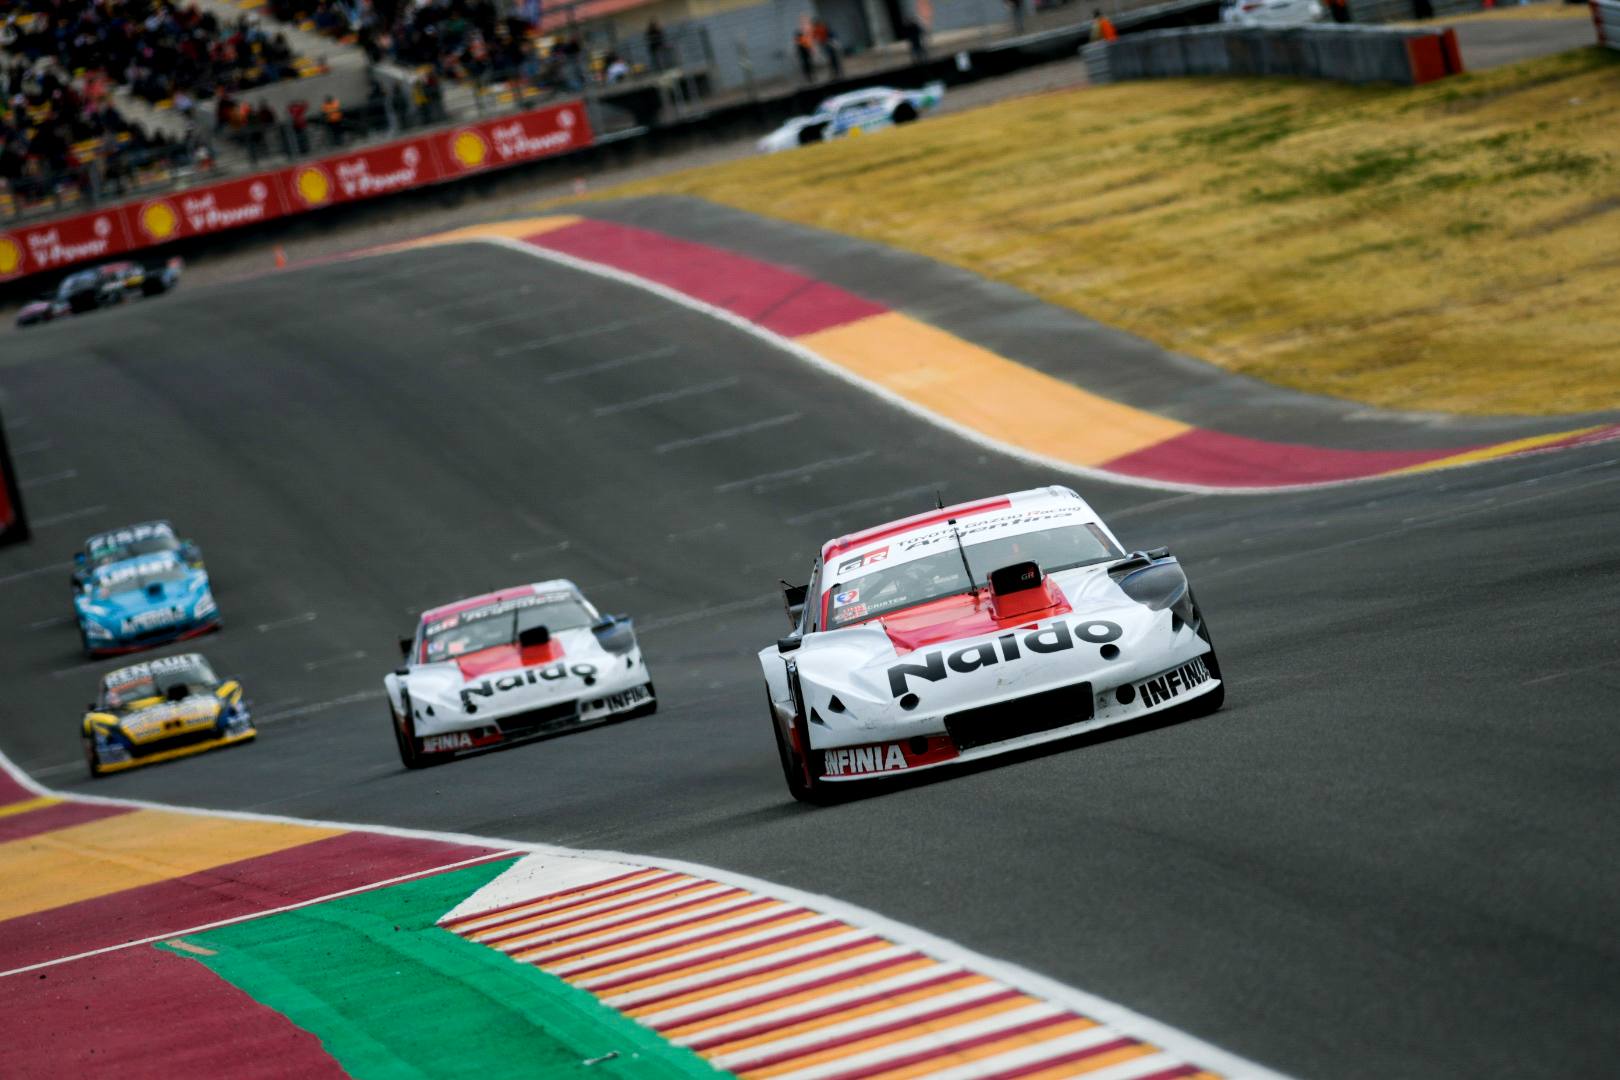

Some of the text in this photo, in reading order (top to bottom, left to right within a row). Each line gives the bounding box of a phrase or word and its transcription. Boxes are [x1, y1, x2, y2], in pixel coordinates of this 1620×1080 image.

[905, 512, 1073, 552] Argentina
[837, 546, 889, 576] GR
[1021, 567, 1034, 581] GR
[888, 619, 1123, 699] Naldo
[460, 662, 598, 708] Naldo
[1139, 658, 1211, 709] INFINIA
[824, 744, 909, 776] INFINIA
